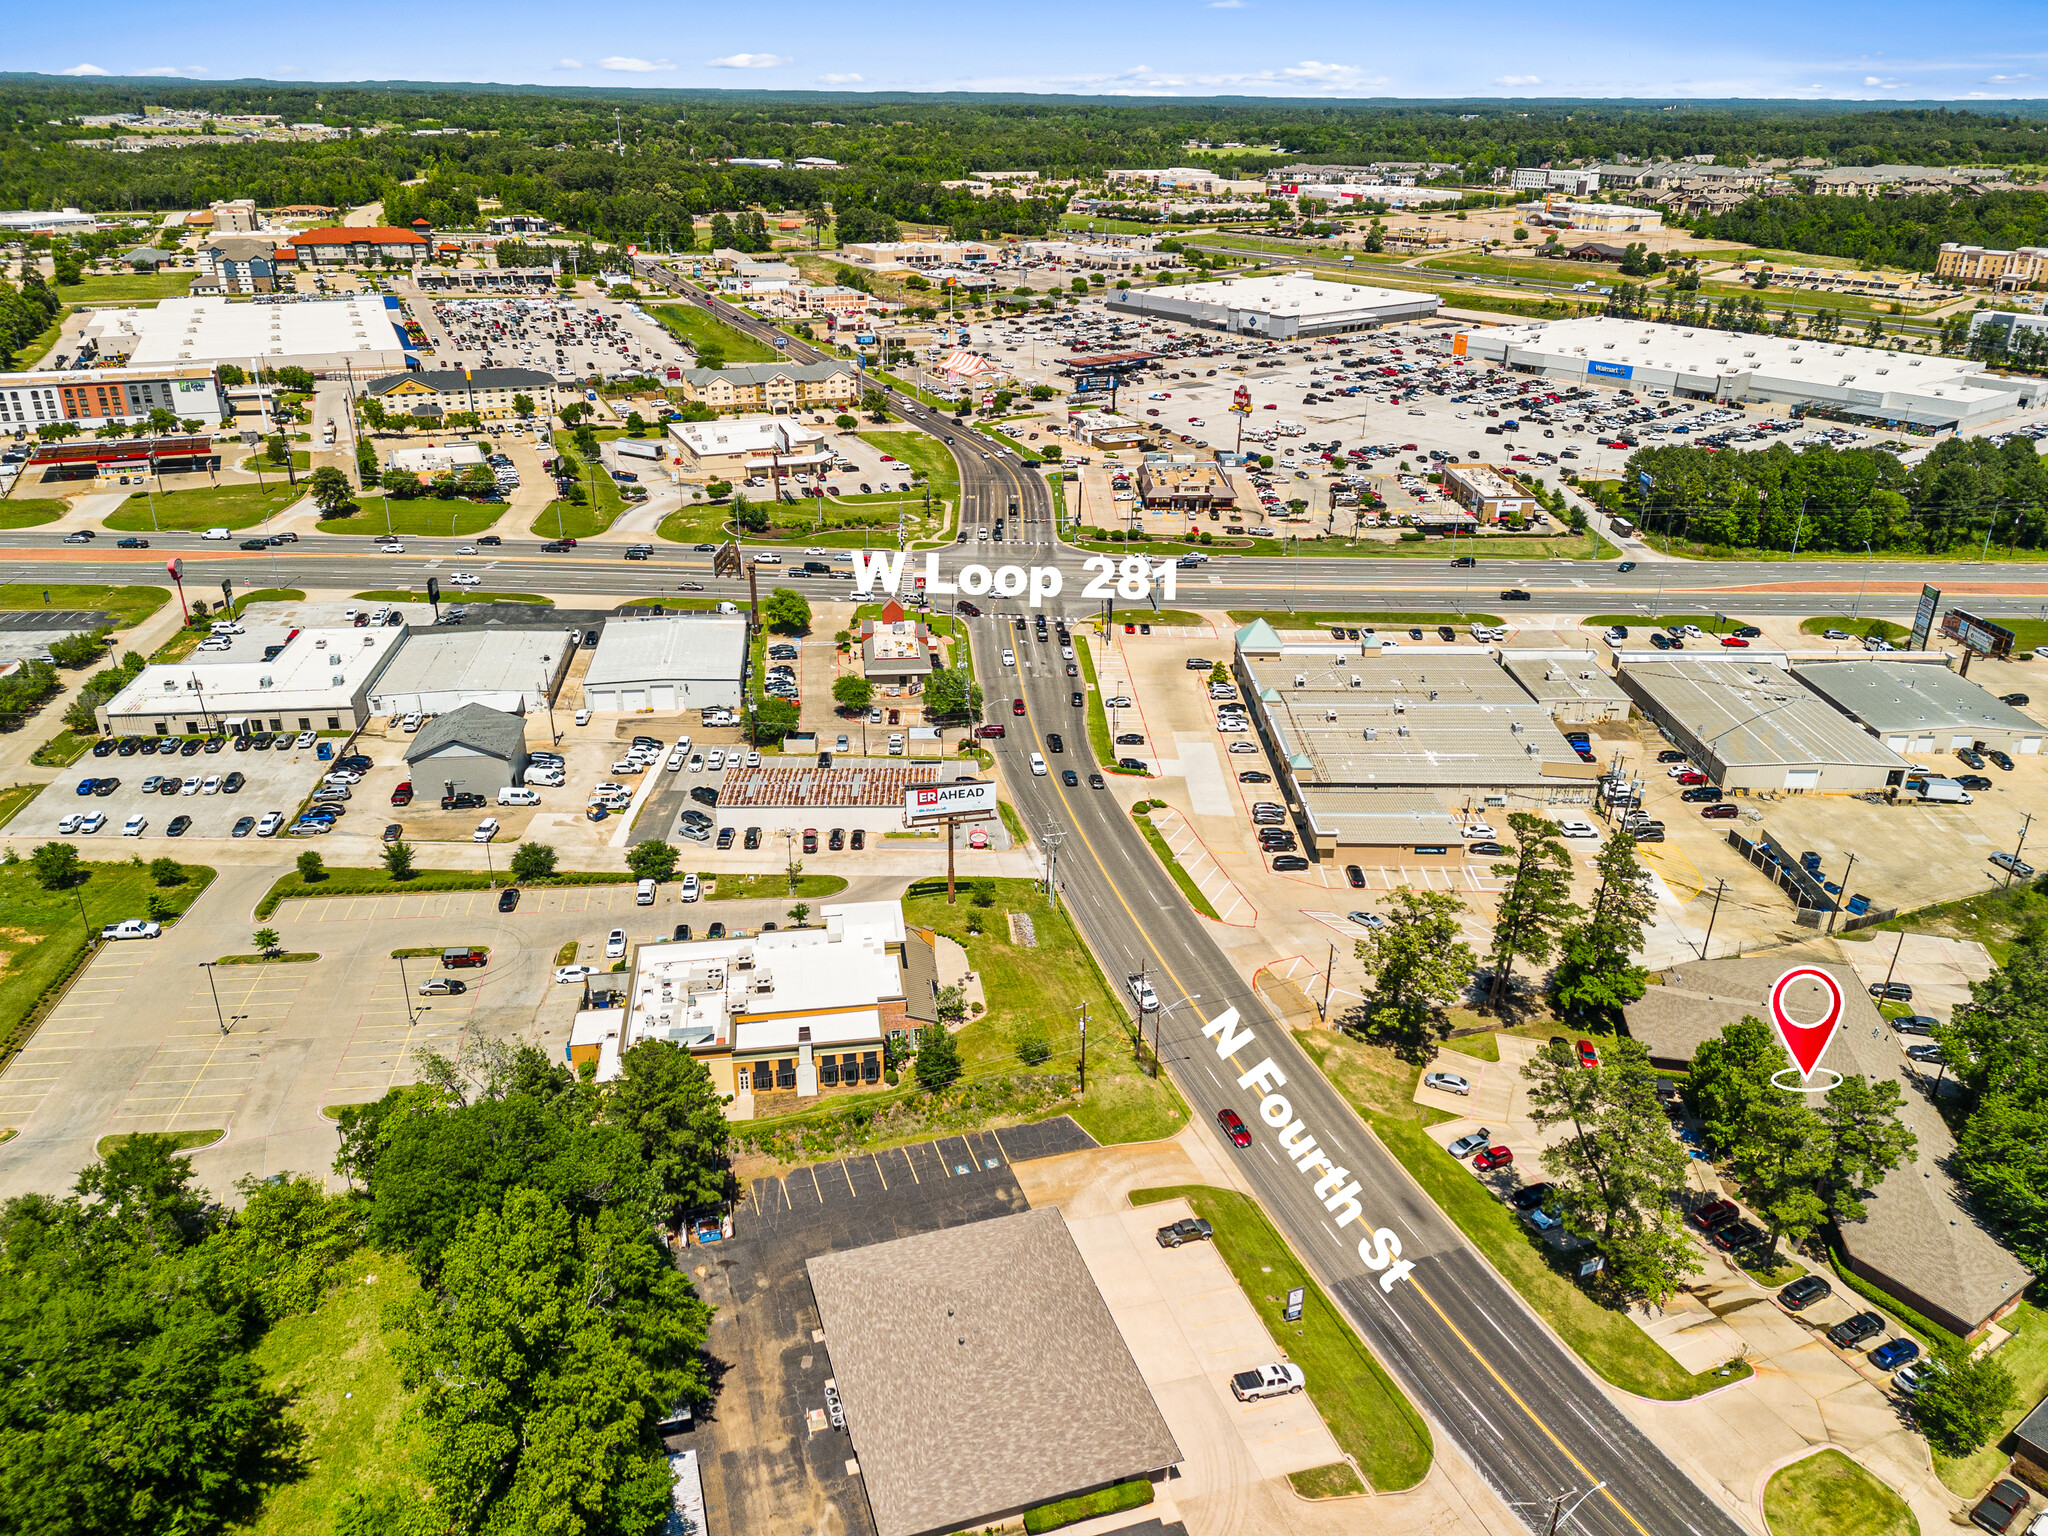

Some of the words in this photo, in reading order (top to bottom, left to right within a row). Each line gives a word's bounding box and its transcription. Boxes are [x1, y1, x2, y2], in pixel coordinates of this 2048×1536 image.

[1595, 364, 1619, 374] Walmart
[919, 791, 937, 803] ER
[939, 788, 985, 801] AHEAD
